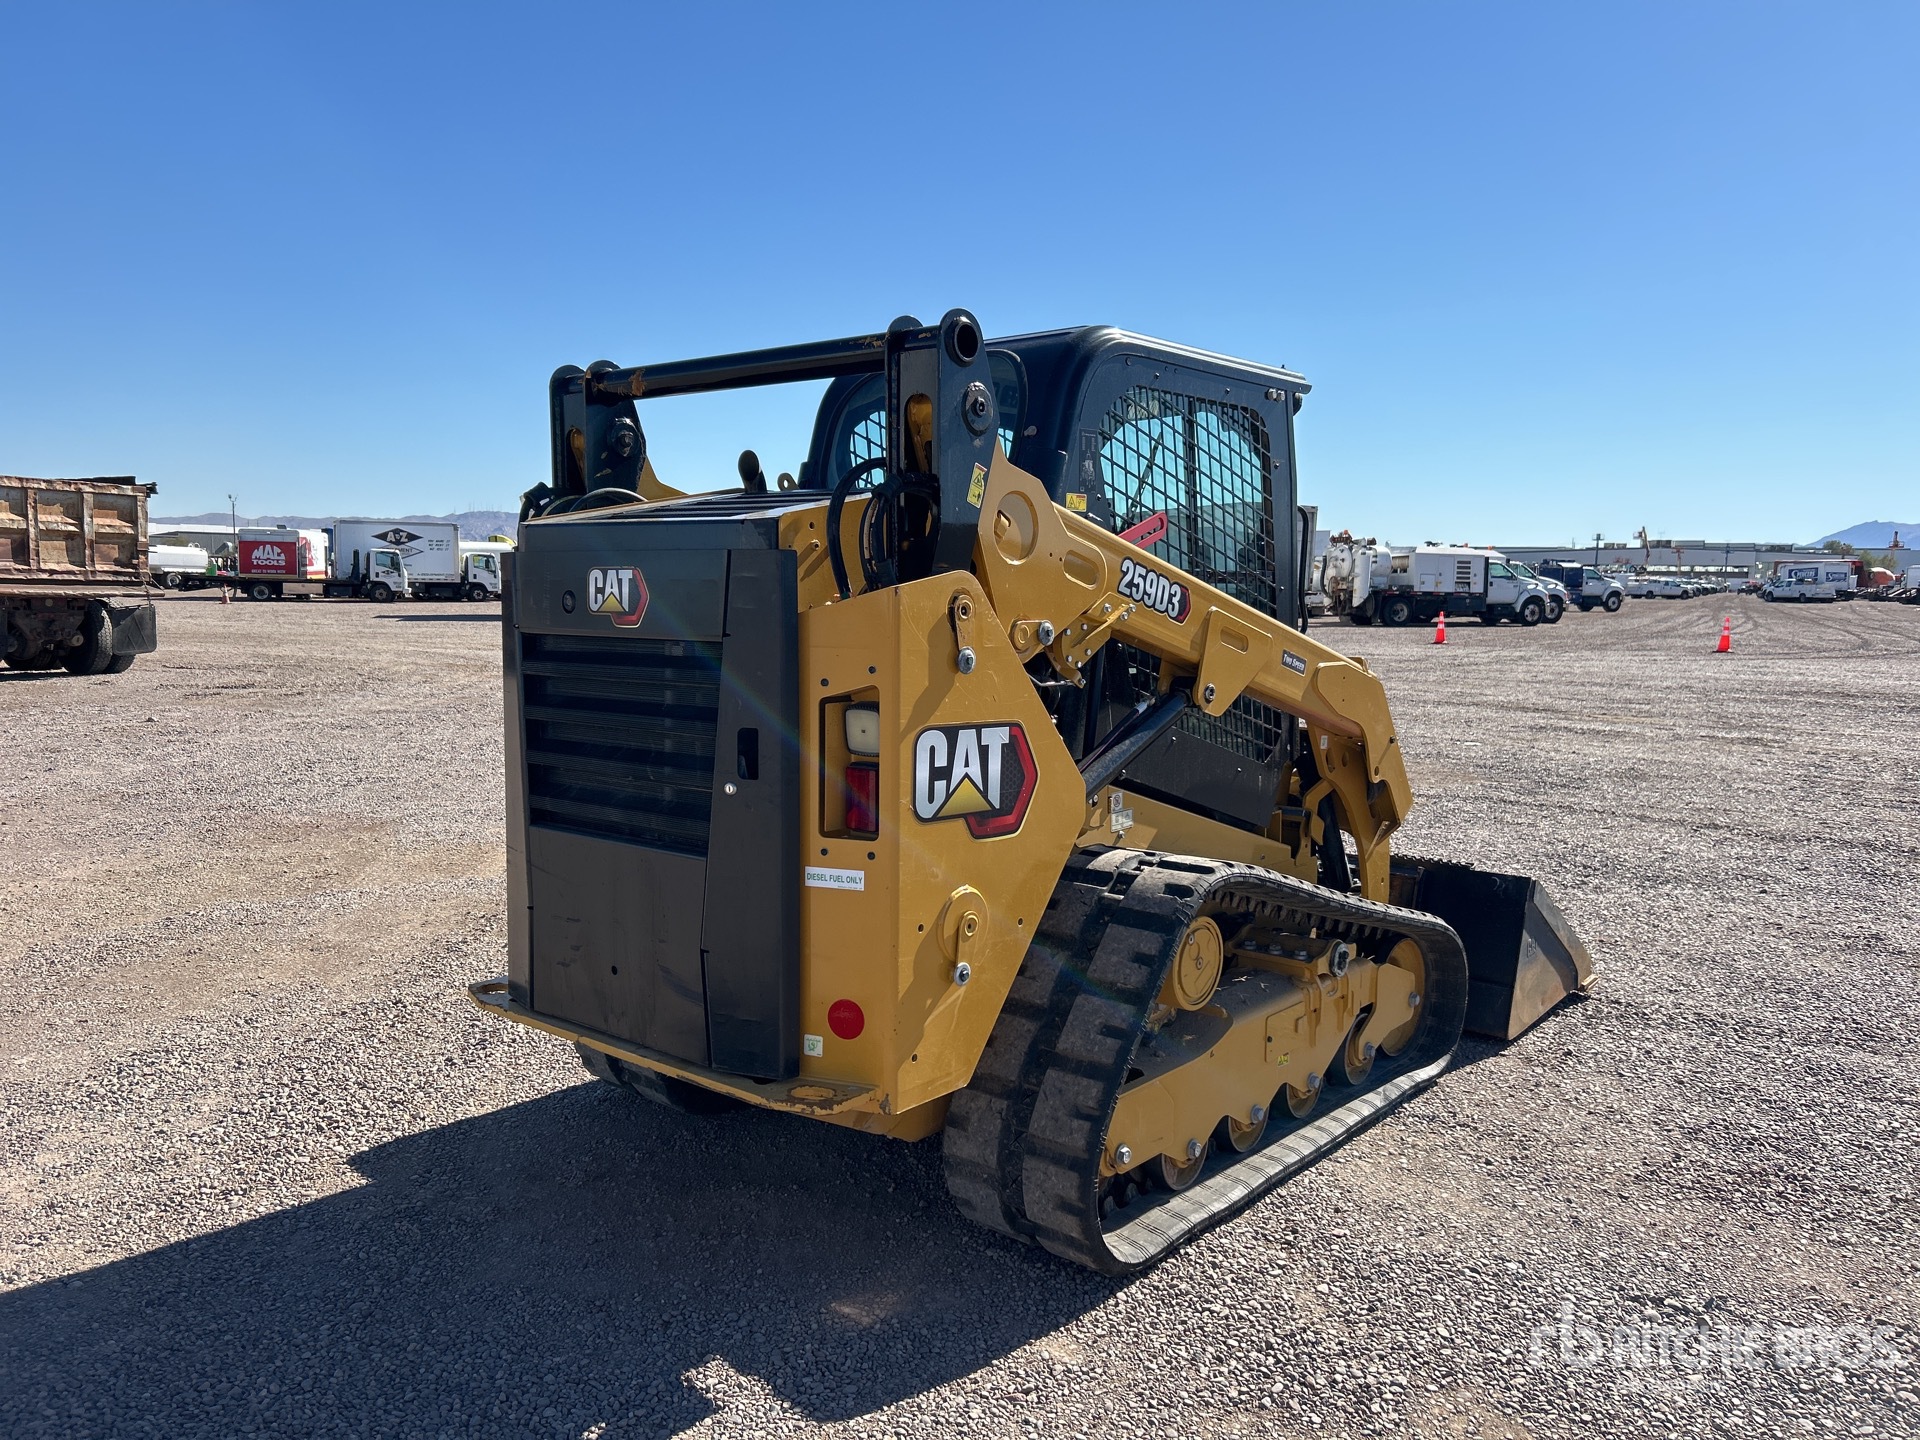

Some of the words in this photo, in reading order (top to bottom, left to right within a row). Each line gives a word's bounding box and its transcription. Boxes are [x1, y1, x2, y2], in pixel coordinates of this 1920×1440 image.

[251, 544, 286, 559] MAC
[588, 569, 633, 612] CAT
[1118, 559, 1181, 618] 259D3
[915, 726, 1010, 819] CAT
[806, 872, 828, 882] DIESEL
[829, 874, 845, 883] FUEL
[845, 875, 863, 885] ONLY
